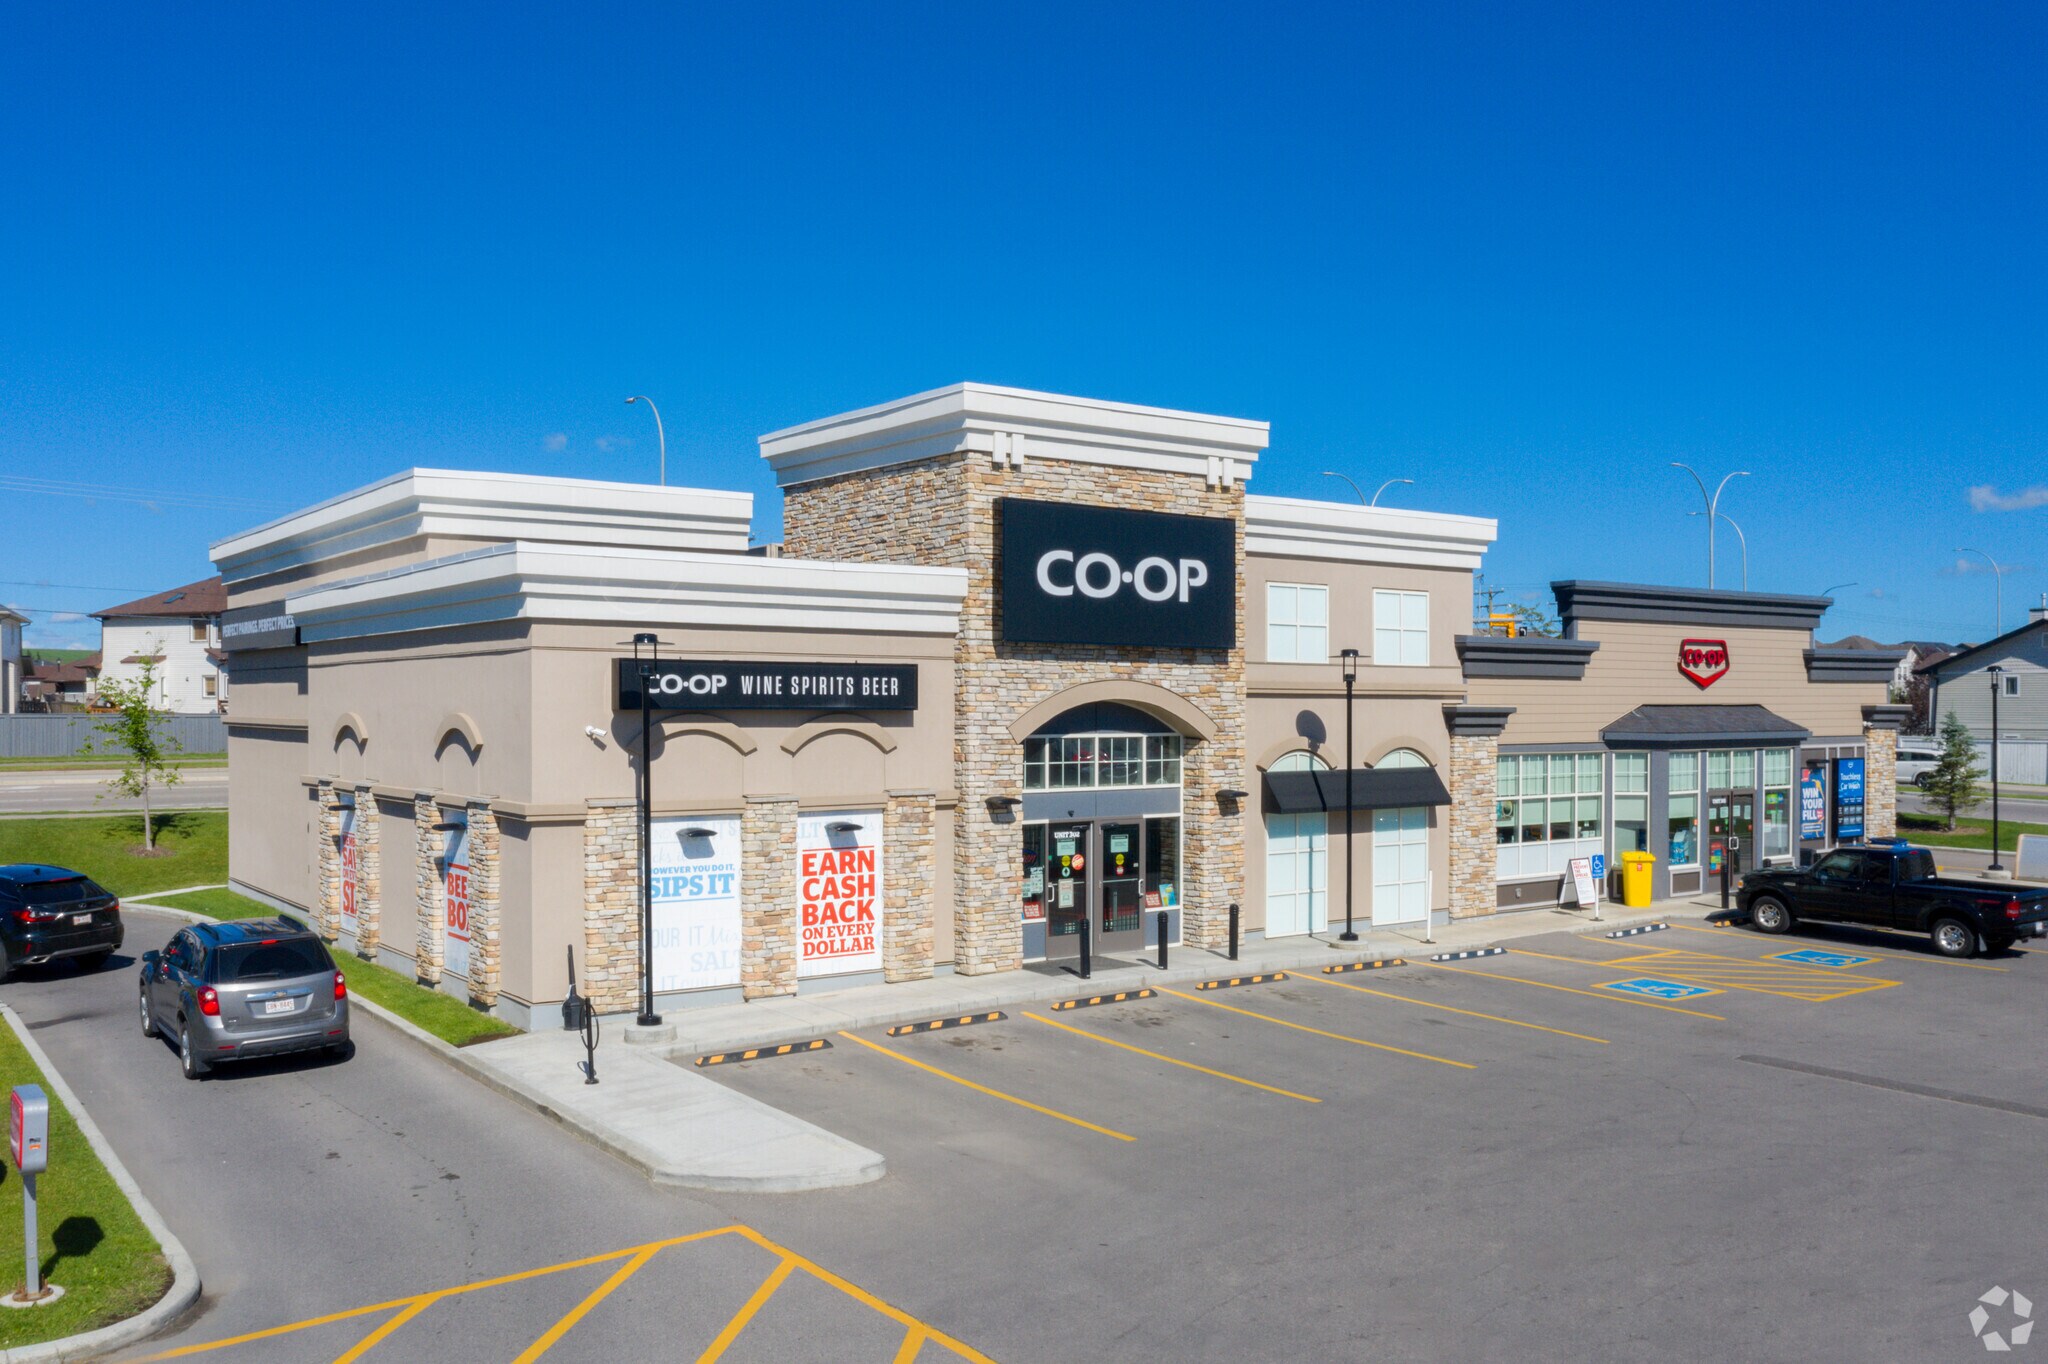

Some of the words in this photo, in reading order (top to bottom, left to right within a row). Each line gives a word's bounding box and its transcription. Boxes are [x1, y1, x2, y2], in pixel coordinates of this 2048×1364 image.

[741, 675, 782, 695] WINE
[791, 676, 854, 696] SPIRITS
[862, 677, 899, 696] BEER
[1802, 788, 1819, 798] WIN
[1802, 798, 1823, 809] YOUR
[1802, 810, 1817, 820] FILL
[651, 866, 691, 875] OWEVER
[692, 865, 711, 873] YOU
[802, 850, 875, 877] EARN
[707, 873, 735, 895] IT
[802, 874, 875, 901] CASH
[802, 899, 875, 927] BACK
[802, 926, 824, 940] ON
[827, 922, 875, 938] EVERY
[802, 936, 875, 957] DOLLAR
